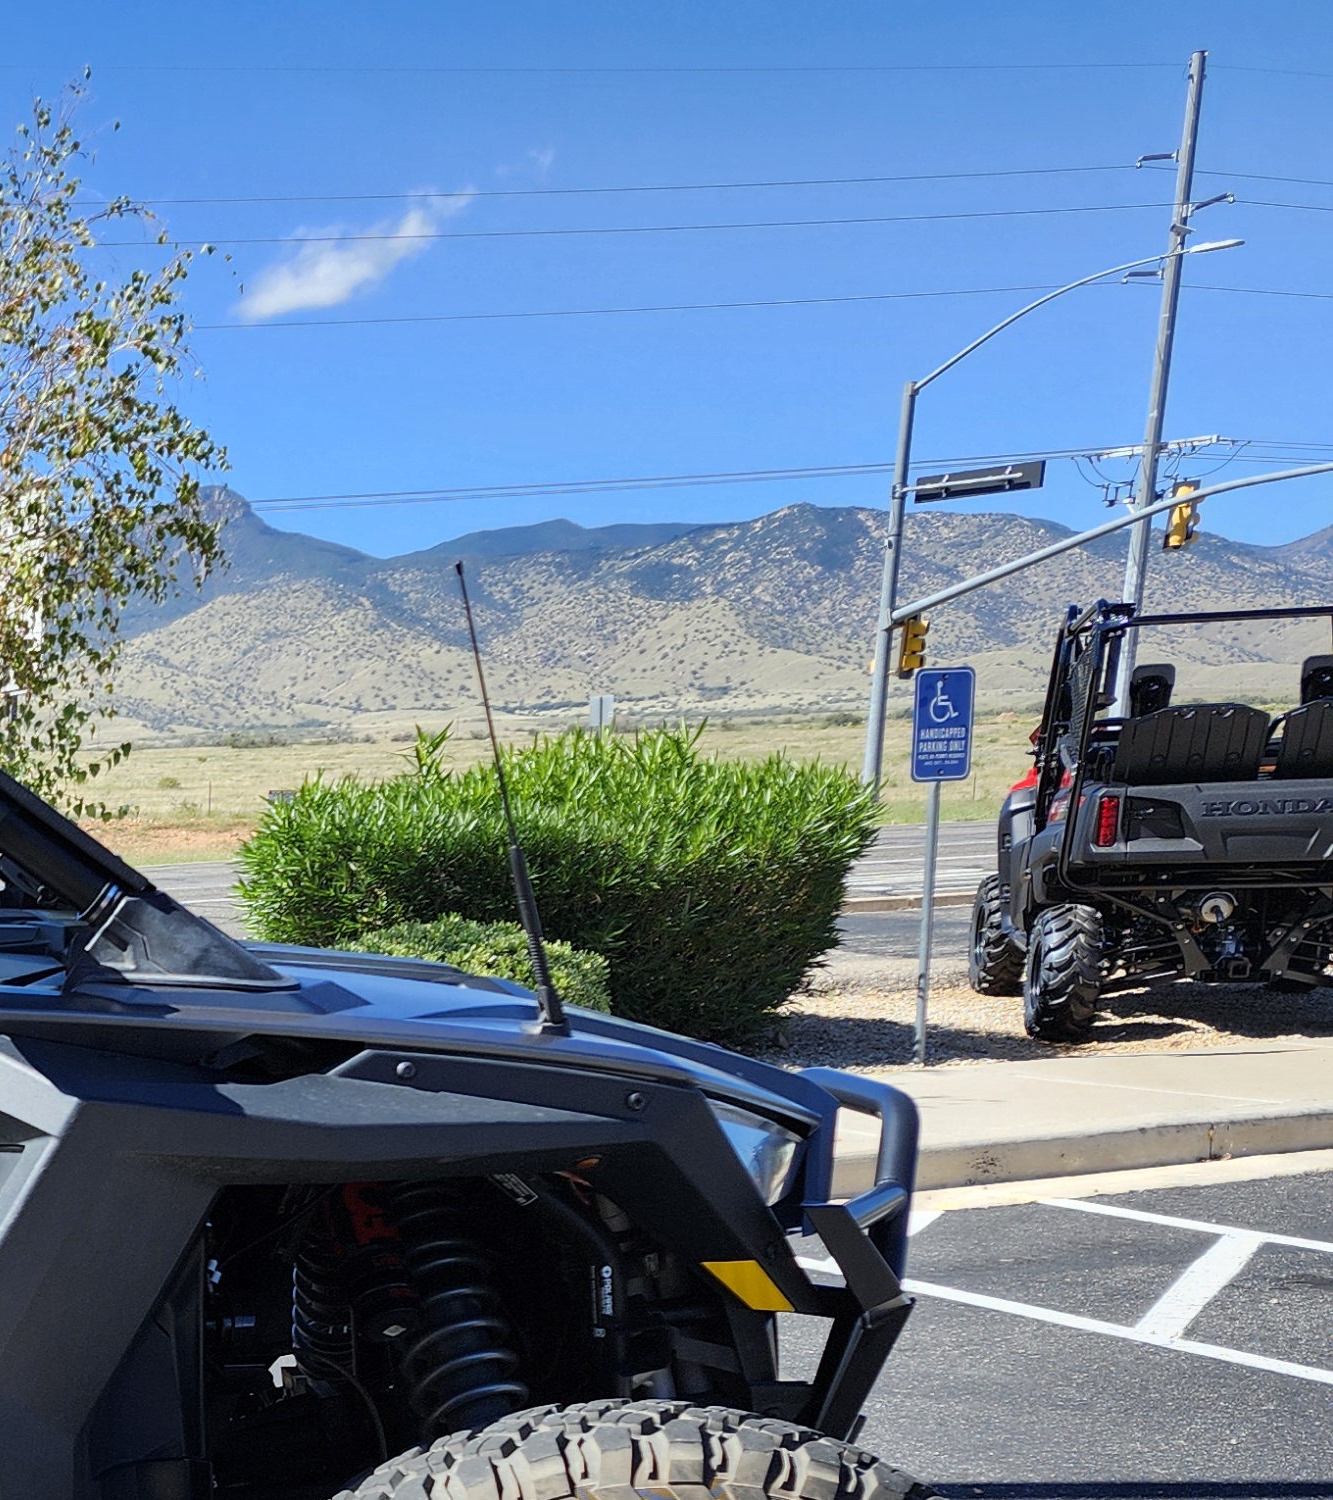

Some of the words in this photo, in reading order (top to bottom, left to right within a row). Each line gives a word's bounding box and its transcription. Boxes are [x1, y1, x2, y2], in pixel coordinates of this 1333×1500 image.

[920, 727, 967, 740] HANDICAPPED
[918, 741, 948, 753] PARKING
[949, 740, 967, 752] ONLY
[1201, 798, 1333, 817] HONDA
